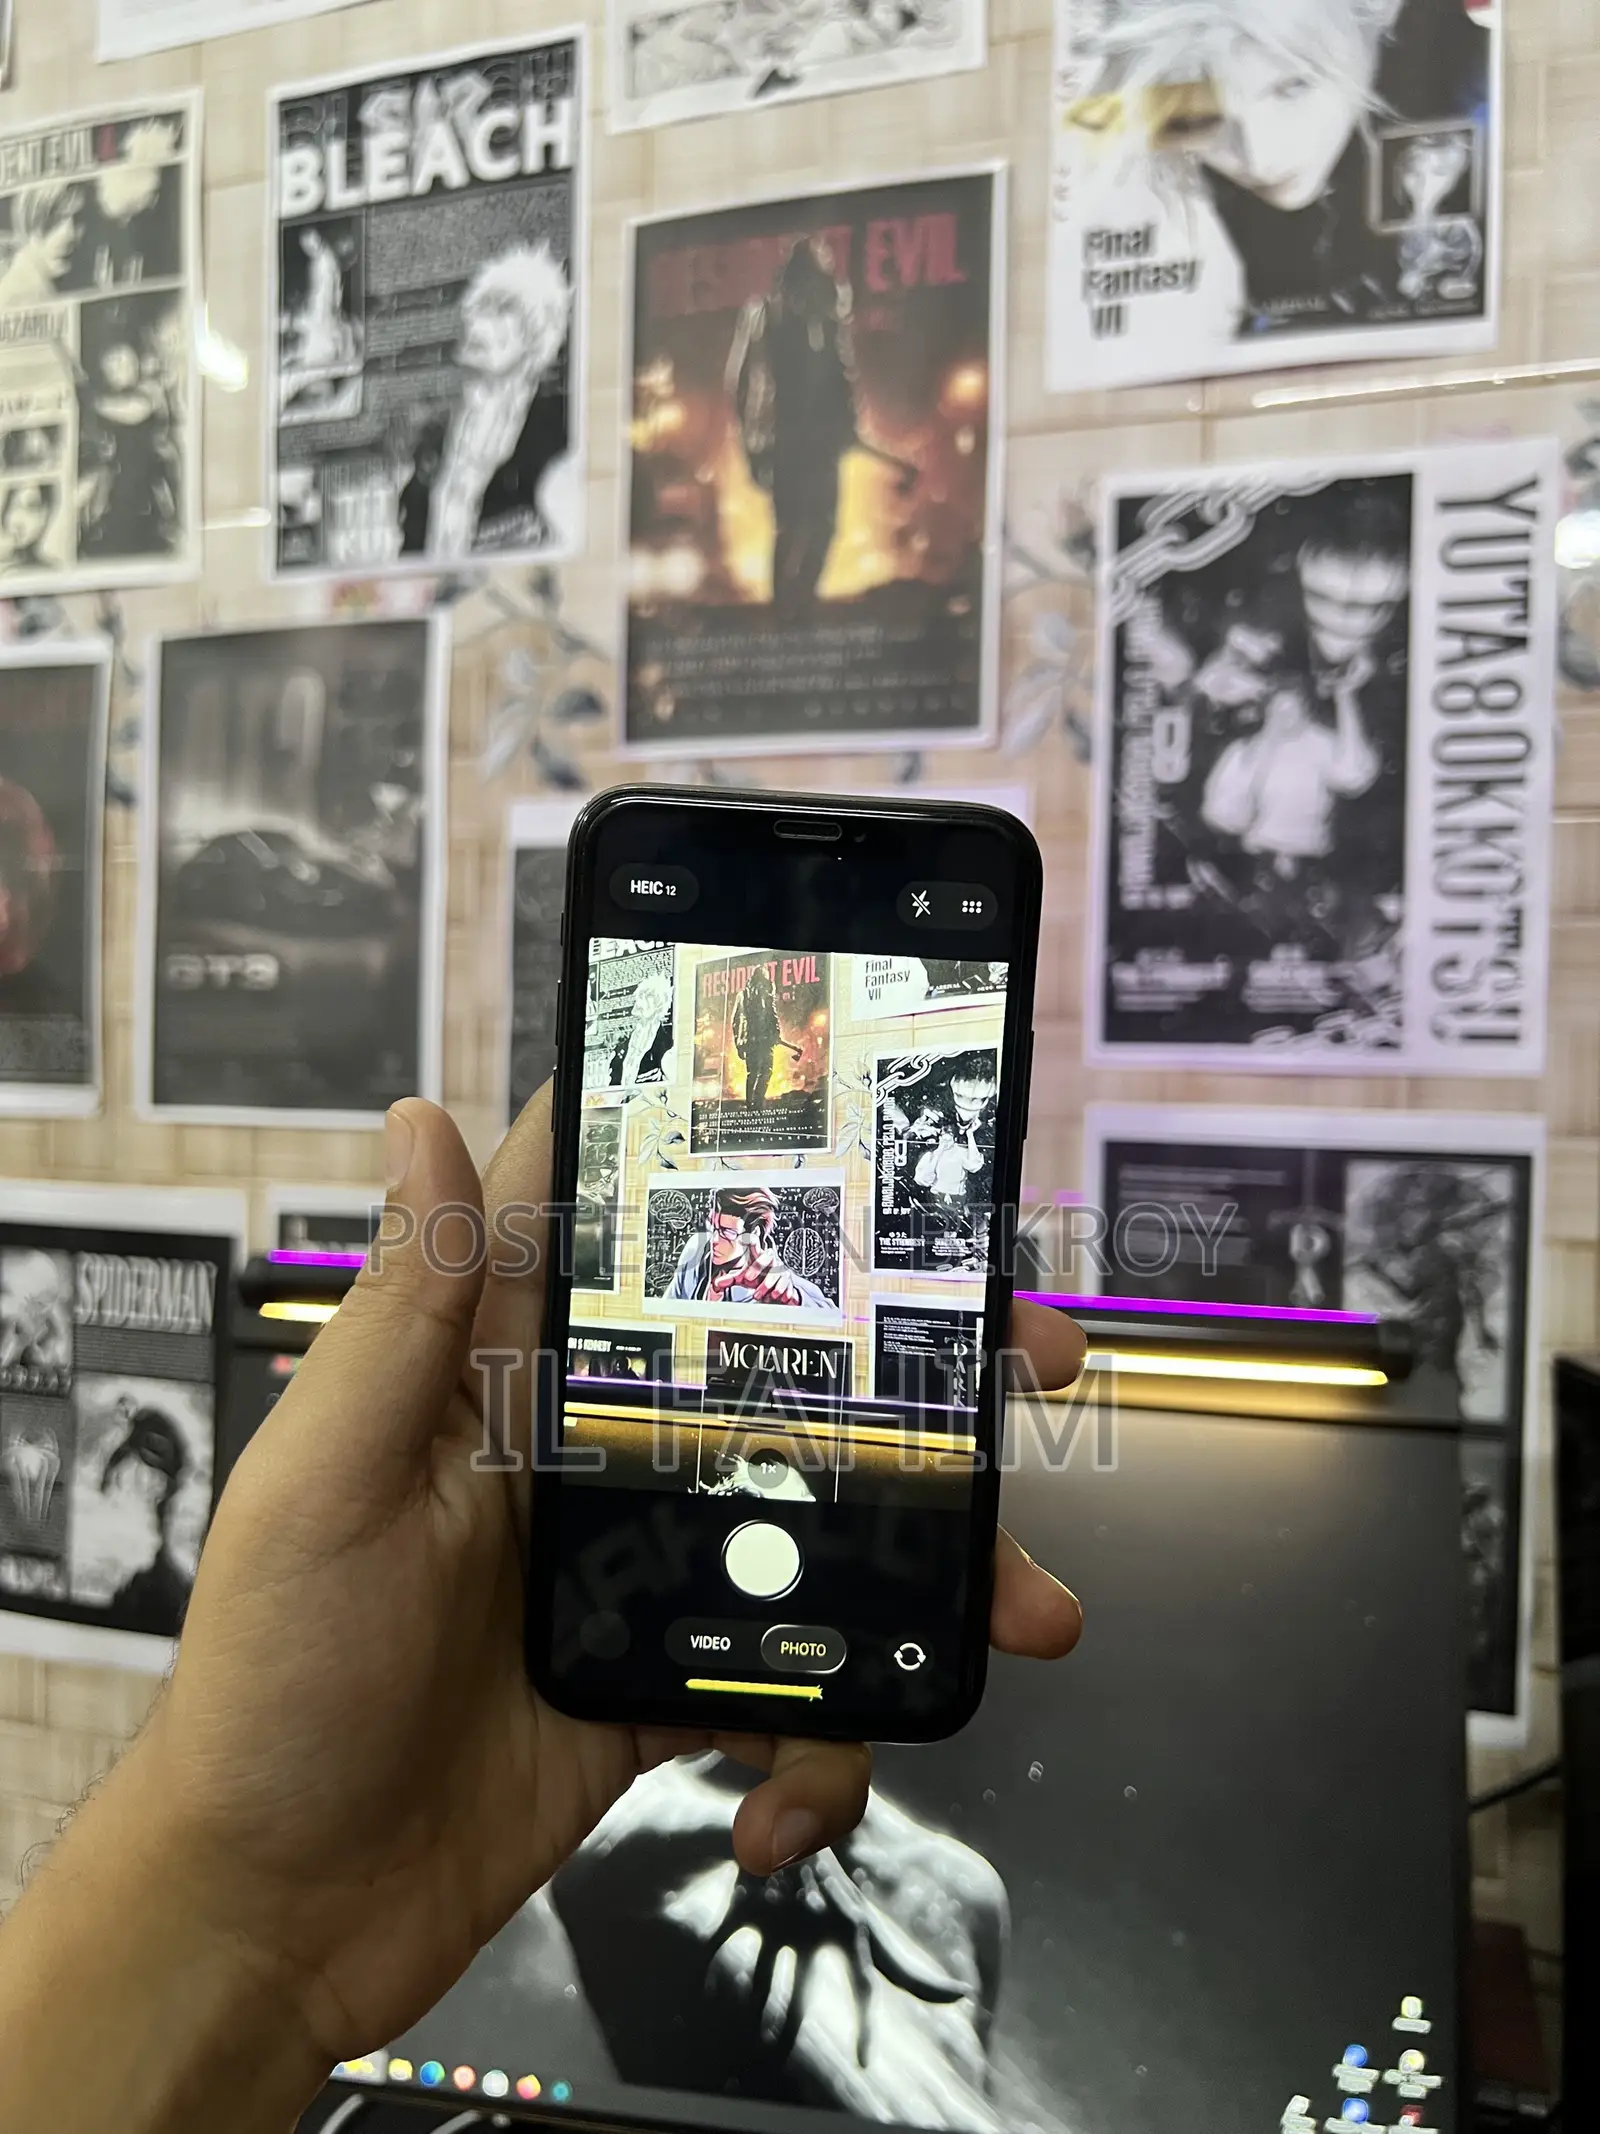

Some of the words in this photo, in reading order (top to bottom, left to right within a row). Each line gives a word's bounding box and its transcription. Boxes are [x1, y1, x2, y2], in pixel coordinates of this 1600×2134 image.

[279, 97, 576, 220] BLEACH
[865, 213, 967, 291] EVIL
[1082, 223, 1156, 268] Final
[1081, 259, 1202, 304] Fantasy
[630, 879, 663, 895] HEIC
[665, 885, 677, 896] 12
[782, 955, 820, 987] EVIL
[865, 957, 892, 974] Final
[865, 969, 911, 988] Fantasy
[868, 987, 881, 1001] VII
[73, 1251, 218, 1334] SPIDERMAN
[719, 1341, 837, 1378] MCLAREN
[690, 1634, 731, 1650] VIDEO
[780, 1640, 827, 1657] PHOTO
